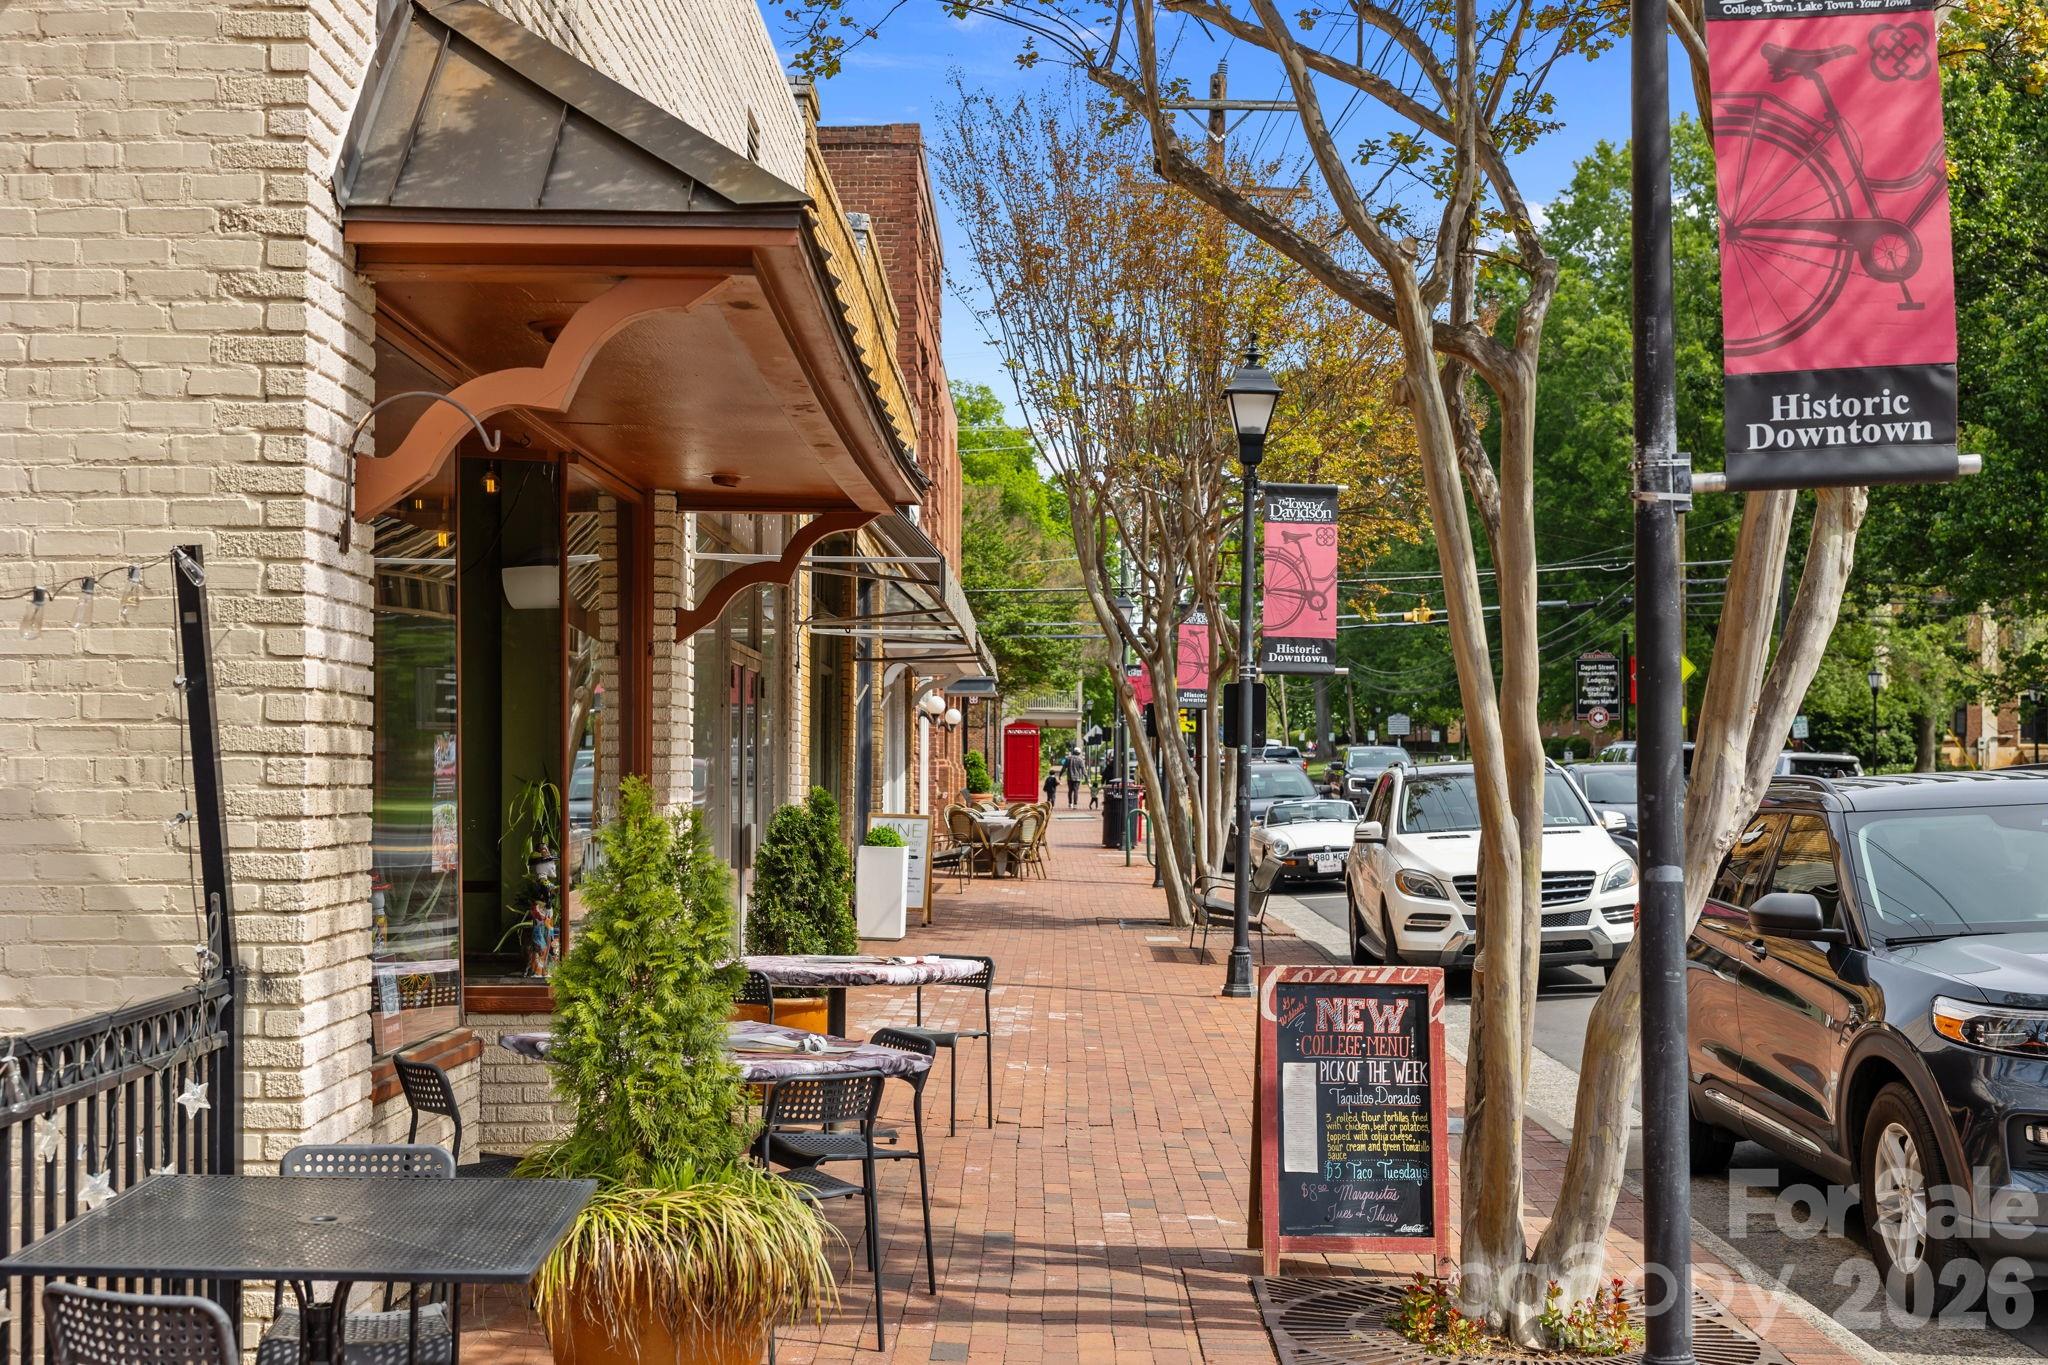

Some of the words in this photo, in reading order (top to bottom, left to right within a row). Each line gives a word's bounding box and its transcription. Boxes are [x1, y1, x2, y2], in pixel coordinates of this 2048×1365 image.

[1723, 4, 1763, 16] College
[1764, 3, 1793, 13] Town
[1797, 1, 1823, 12] Lake
[1825, 0, 1854, 11] Town
[1860, 0, 1882, 9] Your
[1884, 0, 1911, 8] Town
[1769, 388, 1911, 422] Historic
[1746, 419, 1934, 450] Downtown
[1269, 503, 1333, 519] Davidson
[1285, 497, 1315, 509] Town
[1314, 500, 1326, 511] of
[1276, 643, 1321, 654] Historic
[1268, 653, 1328, 663] Downtown
[1315, 997, 1409, 1034] NEW
[1301, 1035, 1362, 1056] COLLEGE
[1365, 1036, 1411, 1058] MENU
[1320, 1060, 1345, 1082] PICK
[1346, 1060, 1364, 1082] OF
[1366, 1060, 1391, 1083] THE
[1393, 1061, 1428, 1084] WEEK
[1329, 1087, 1374, 1113] Taquitos
[1374, 1086, 1421, 1106] Dorados
[1336, 1112, 1358, 1123] rolled
[1361, 1111, 1381, 1122] flour
[1383, 1111, 1409, 1122] tortillas
[1411, 1112, 1428, 1122] fried
[1326, 1121, 1342, 1130] with
[1373, 1122, 1388, 1131] beef
[1327, 1131, 1351, 1144] topped
[1353, 1130, 1369, 1141] with
[1327, 1152, 1348, 1160] sauce
[1345, 1143, 1366, 1152] cream
[1367, 1141, 1381, 1152] and
[1382, 1142, 1401, 1156] green
[1403, 1140, 1430, 1152] tomatillo
[1326, 1160, 1342, 1181] $3
[1346, 1160, 1373, 1179] Taco
[1376, 1159, 1429, 1186] Tuesdays
[1334, 1183, 1400, 1210] Margaritas
[1328, 1203, 1354, 1223] Tues
[1366, 1204, 1399, 1224] Thurs
